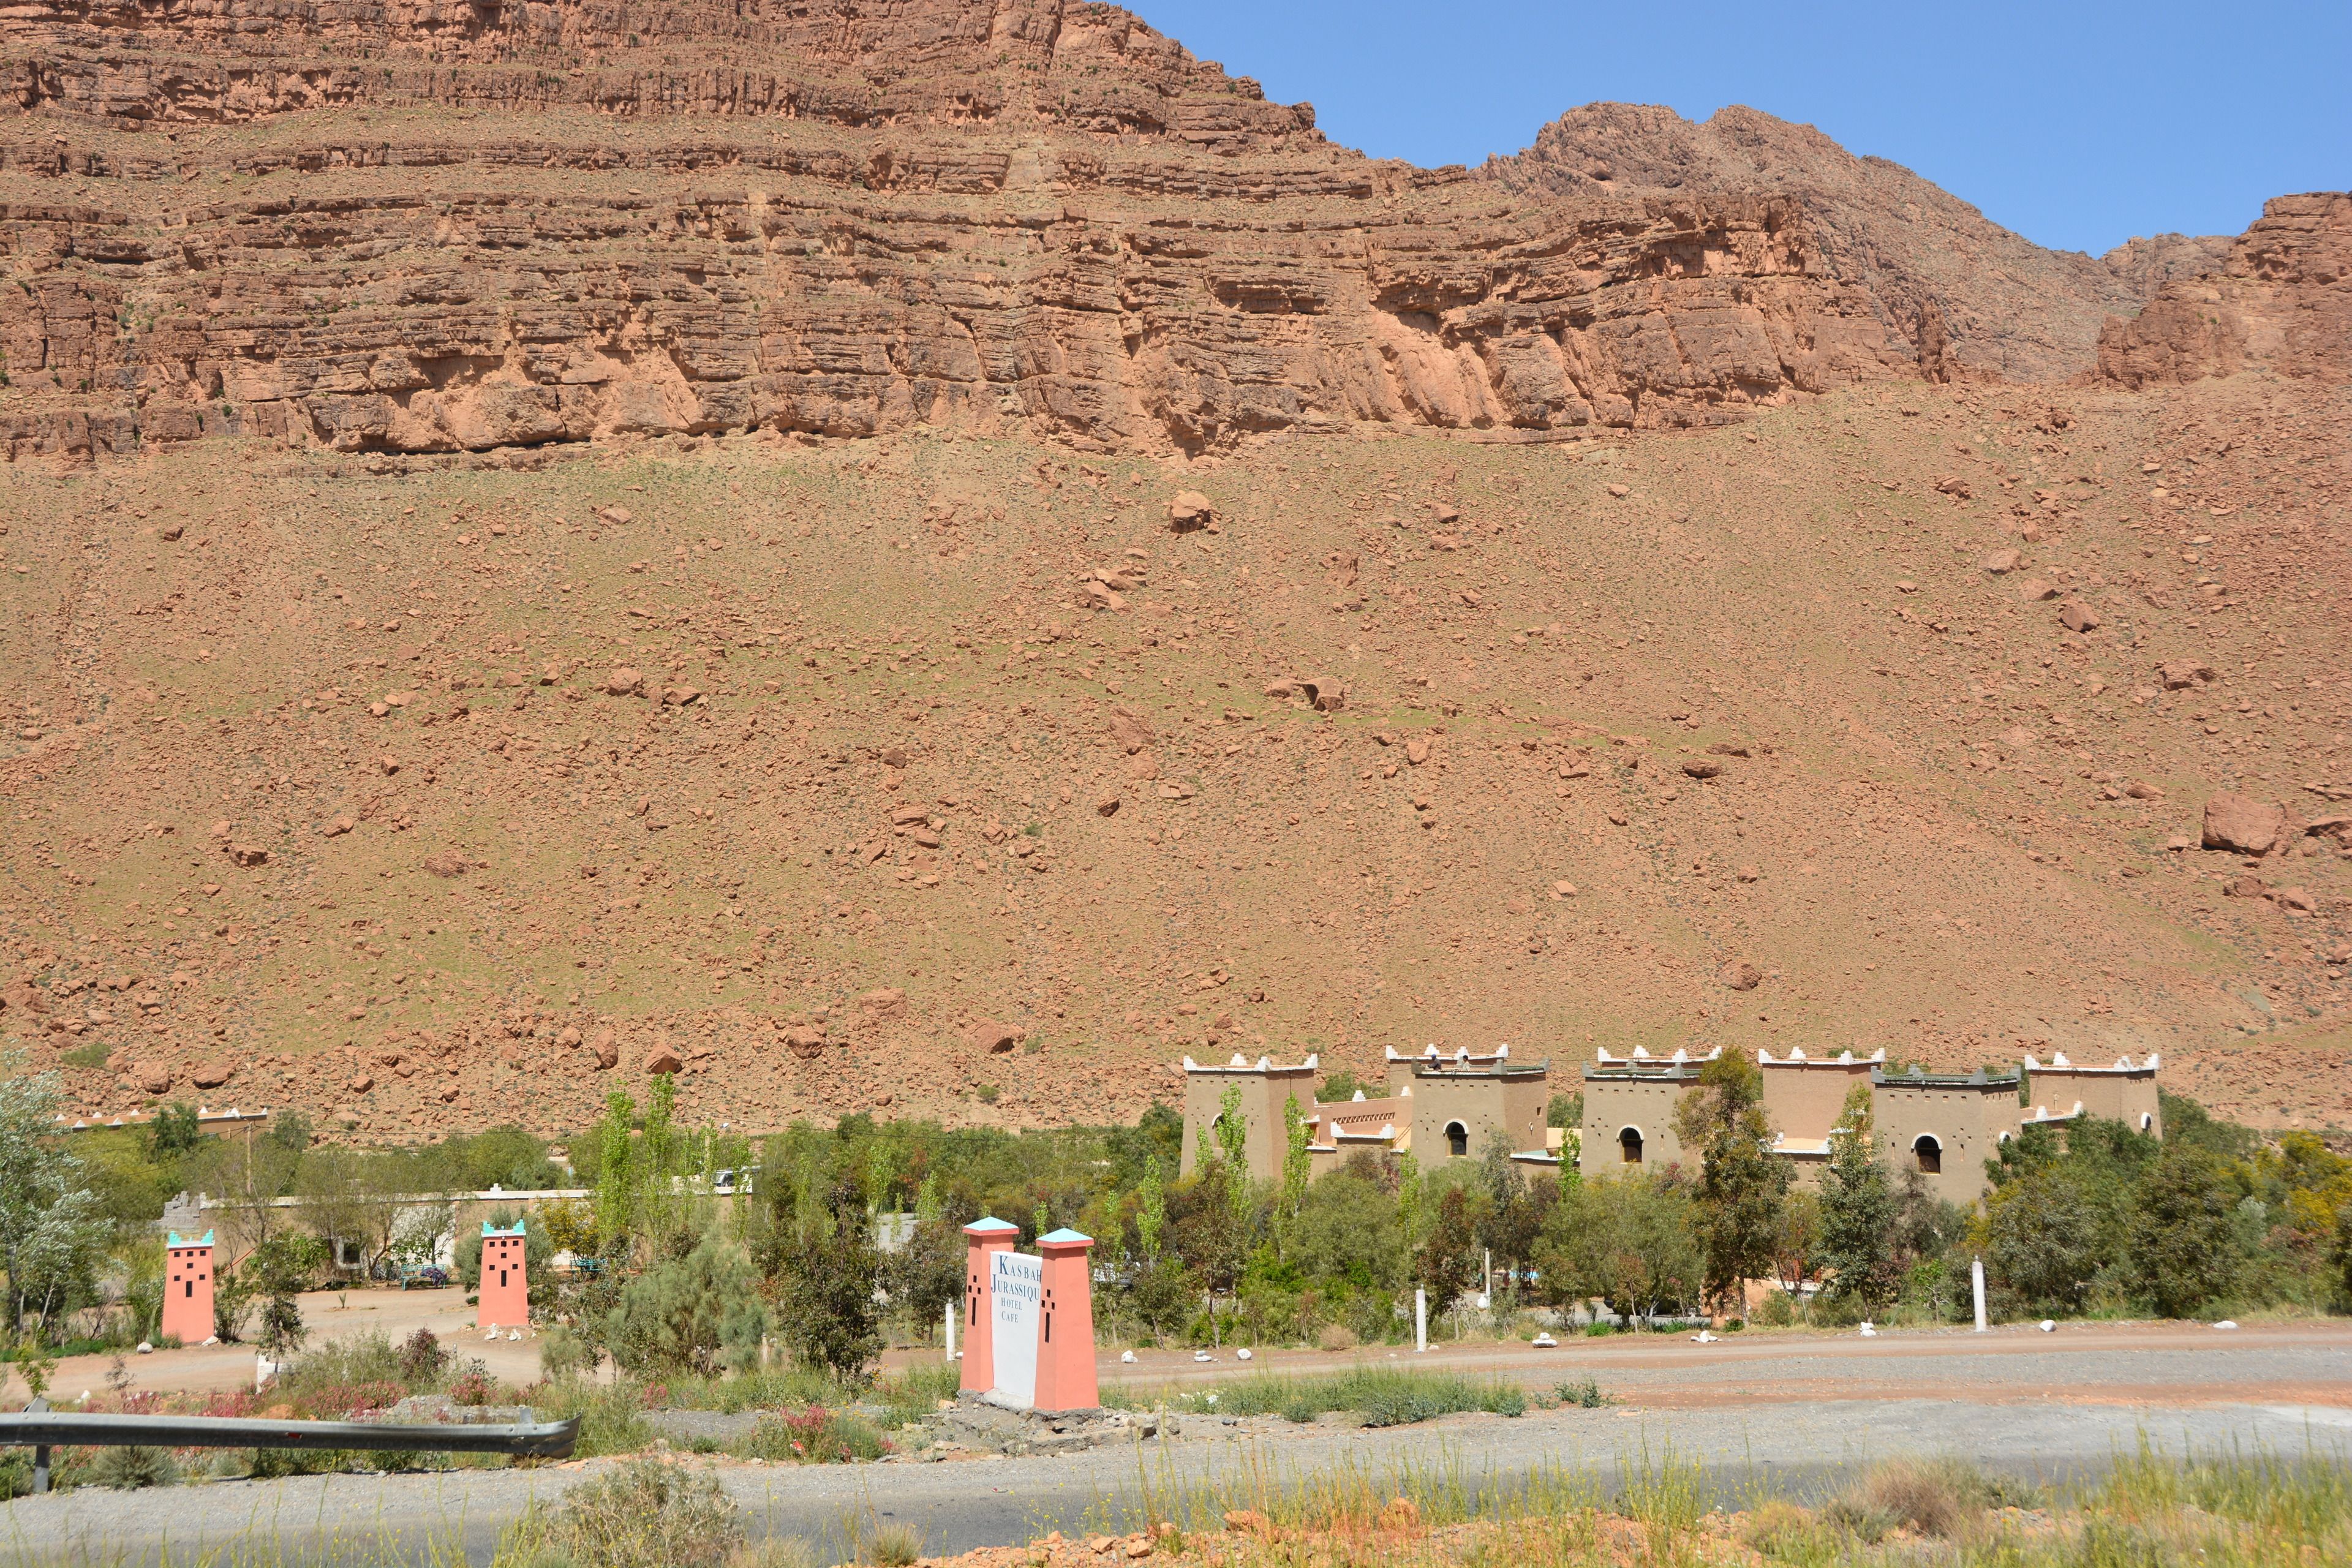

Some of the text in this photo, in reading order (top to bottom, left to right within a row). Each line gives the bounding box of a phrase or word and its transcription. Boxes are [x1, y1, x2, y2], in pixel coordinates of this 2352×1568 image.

[999, 1255, 1042, 1284] KASBAH
[1001, 1297, 1022, 1310] HOTEL
[1001, 1311, 1018, 1323] CAFE
